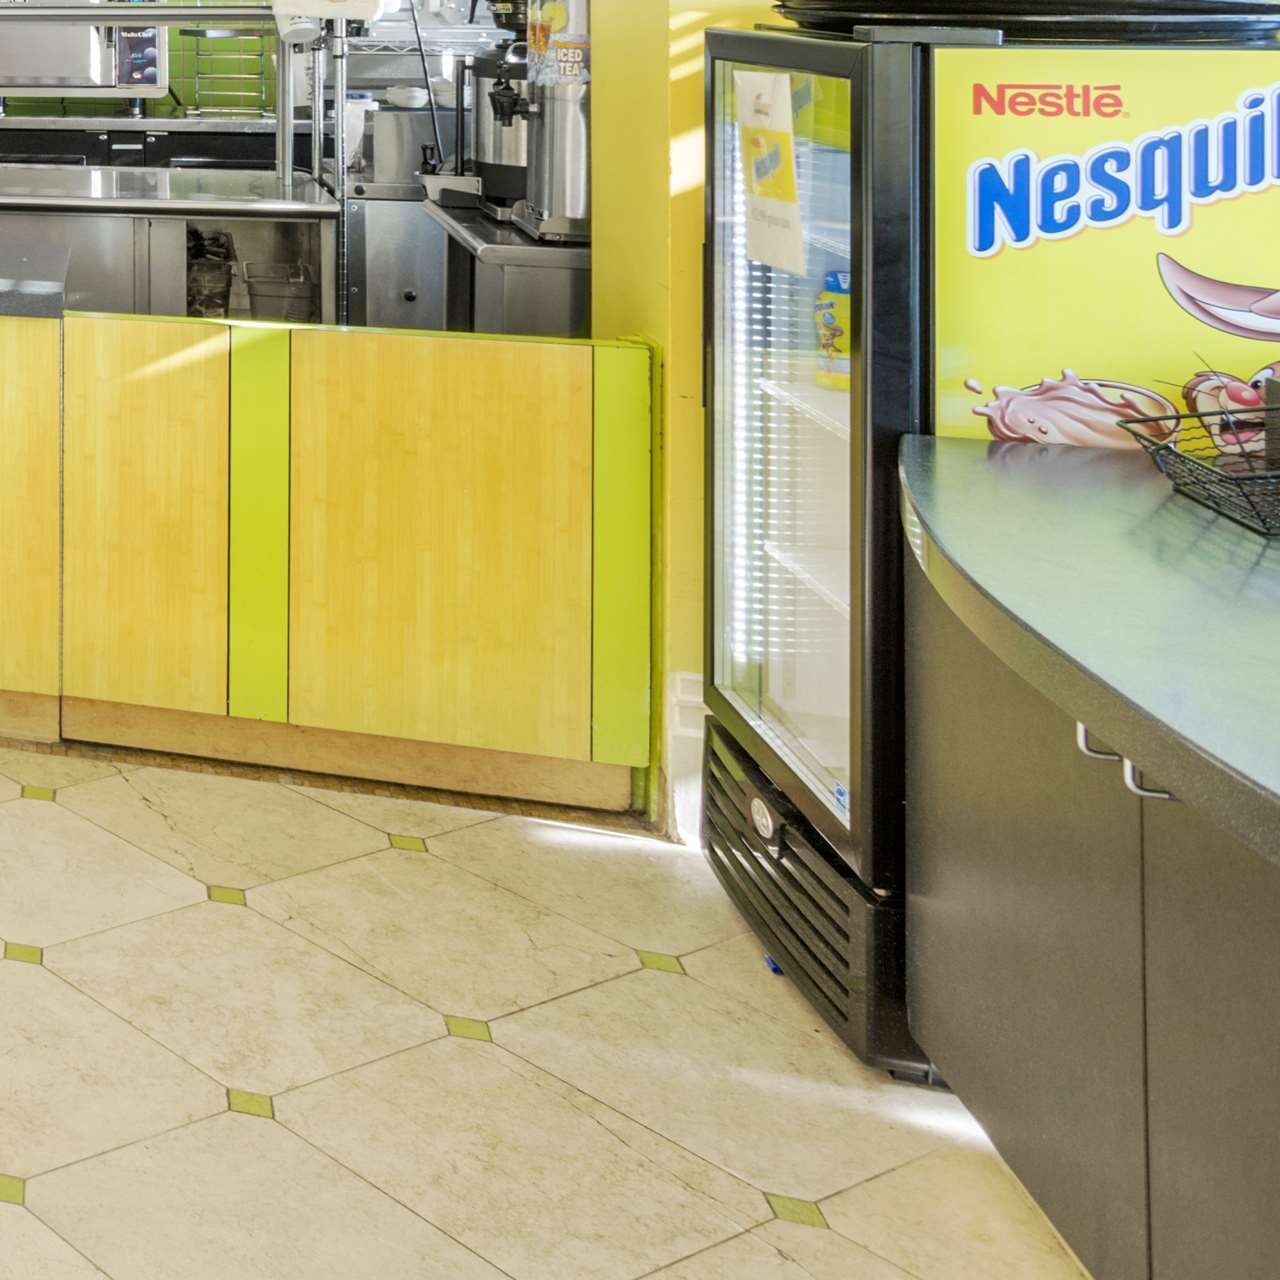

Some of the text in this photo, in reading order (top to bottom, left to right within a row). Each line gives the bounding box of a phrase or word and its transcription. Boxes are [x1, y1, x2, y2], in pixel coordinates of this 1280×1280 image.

[557, 48, 583, 62] ICED
[559, 62, 580, 76] TEA
[972, 83, 1124, 118] Nestlé
